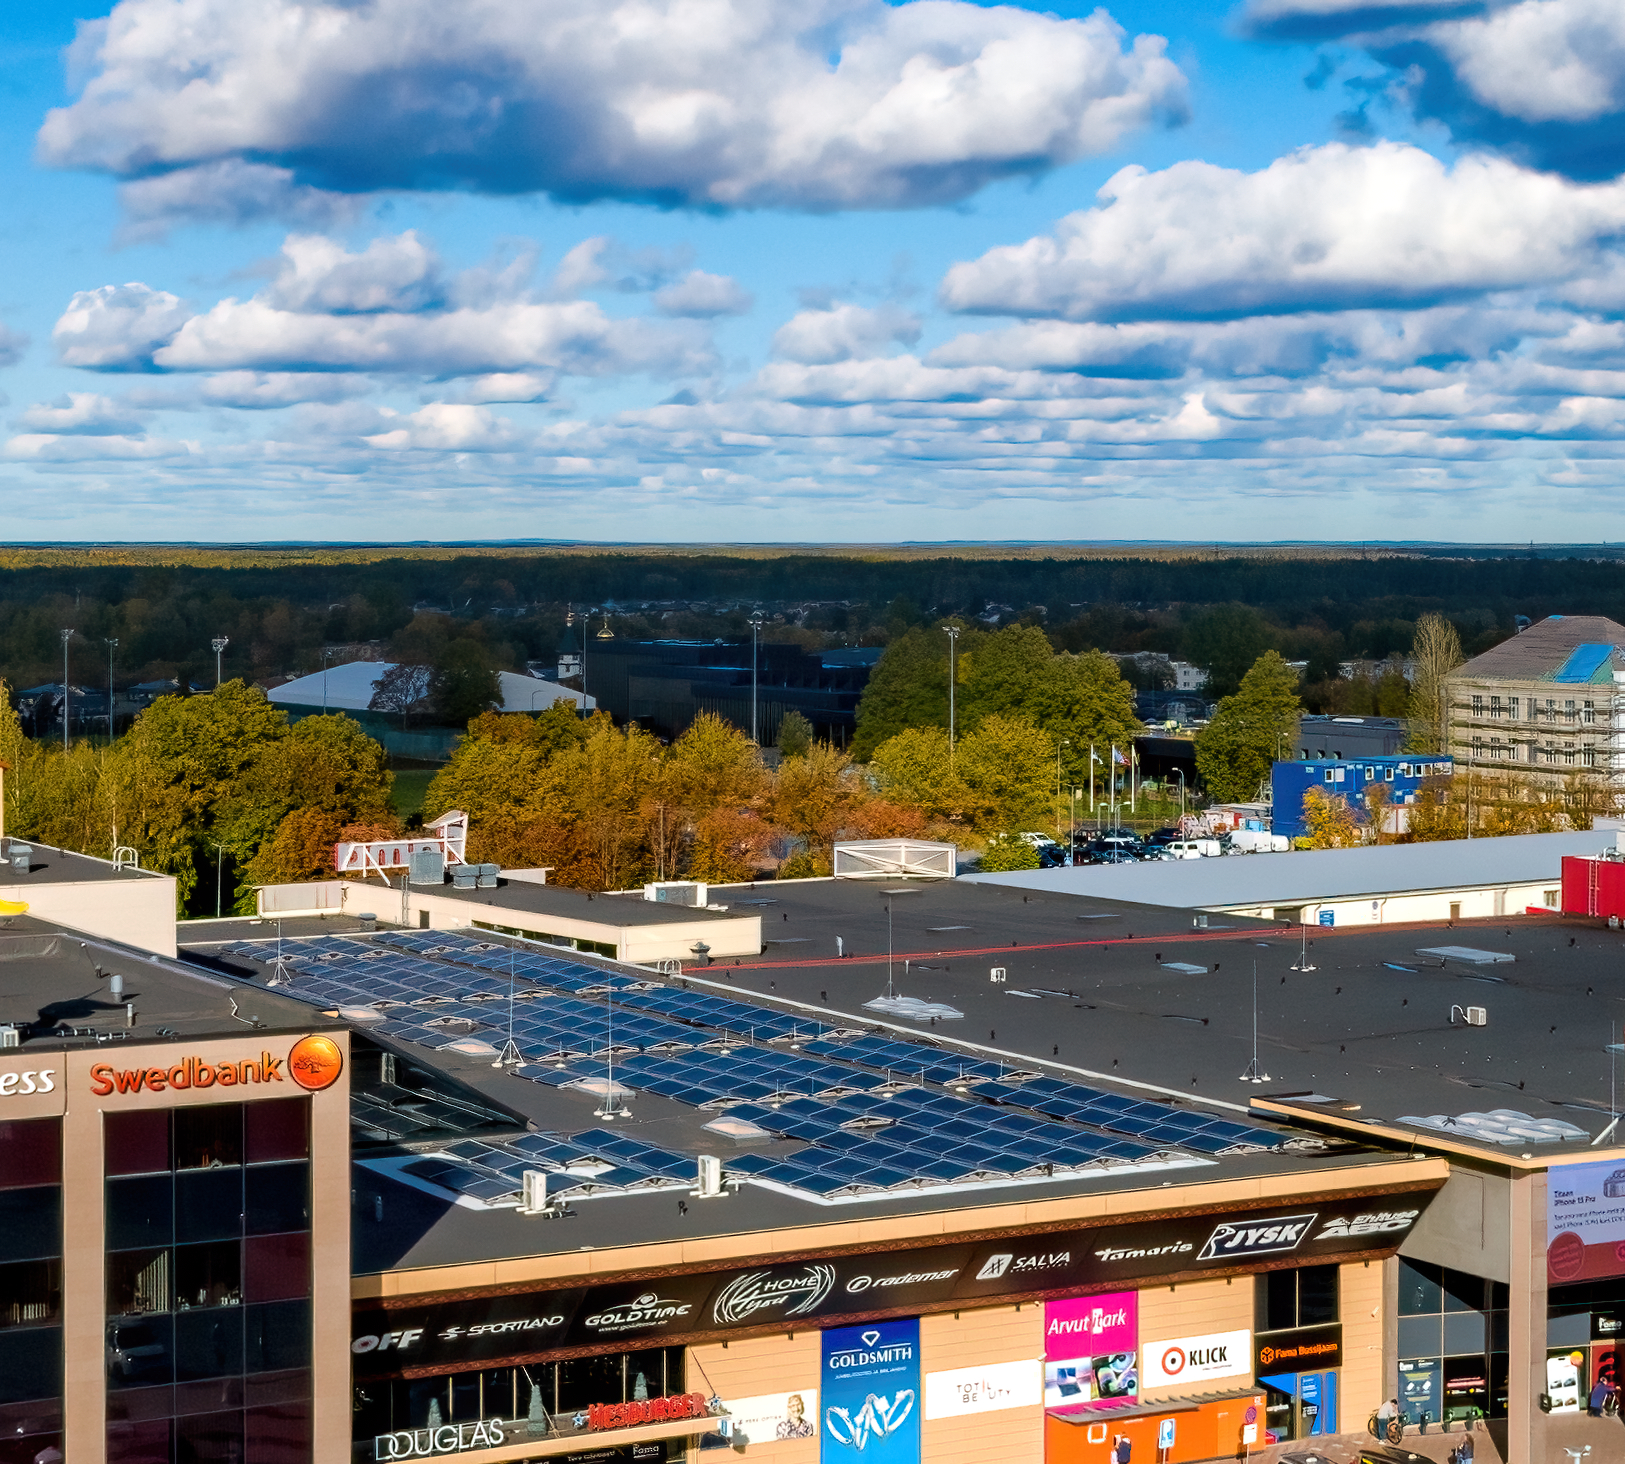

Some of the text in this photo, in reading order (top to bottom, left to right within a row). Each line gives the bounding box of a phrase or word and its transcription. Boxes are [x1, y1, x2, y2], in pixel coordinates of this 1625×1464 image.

[90, 1052, 284, 1098] Swedbank
[1224, 1224, 1306, 1248] JYSK
[1013, 1252, 1070, 1270] SALVA
[764, 1275, 817, 1290] HOME
[872, 1269, 959, 1288] rademar
[585, 1304, 692, 1326] GOLDTIME
[467, 1316, 564, 1337] SPORTLAND
[830, 1346, 912, 1369] GOLDSMITH
[1189, 1346, 1227, 1366] KLICK
[962, 1389, 1011, 1403] BEUTY
[376, 1418, 504, 1461] DOUGLAS
